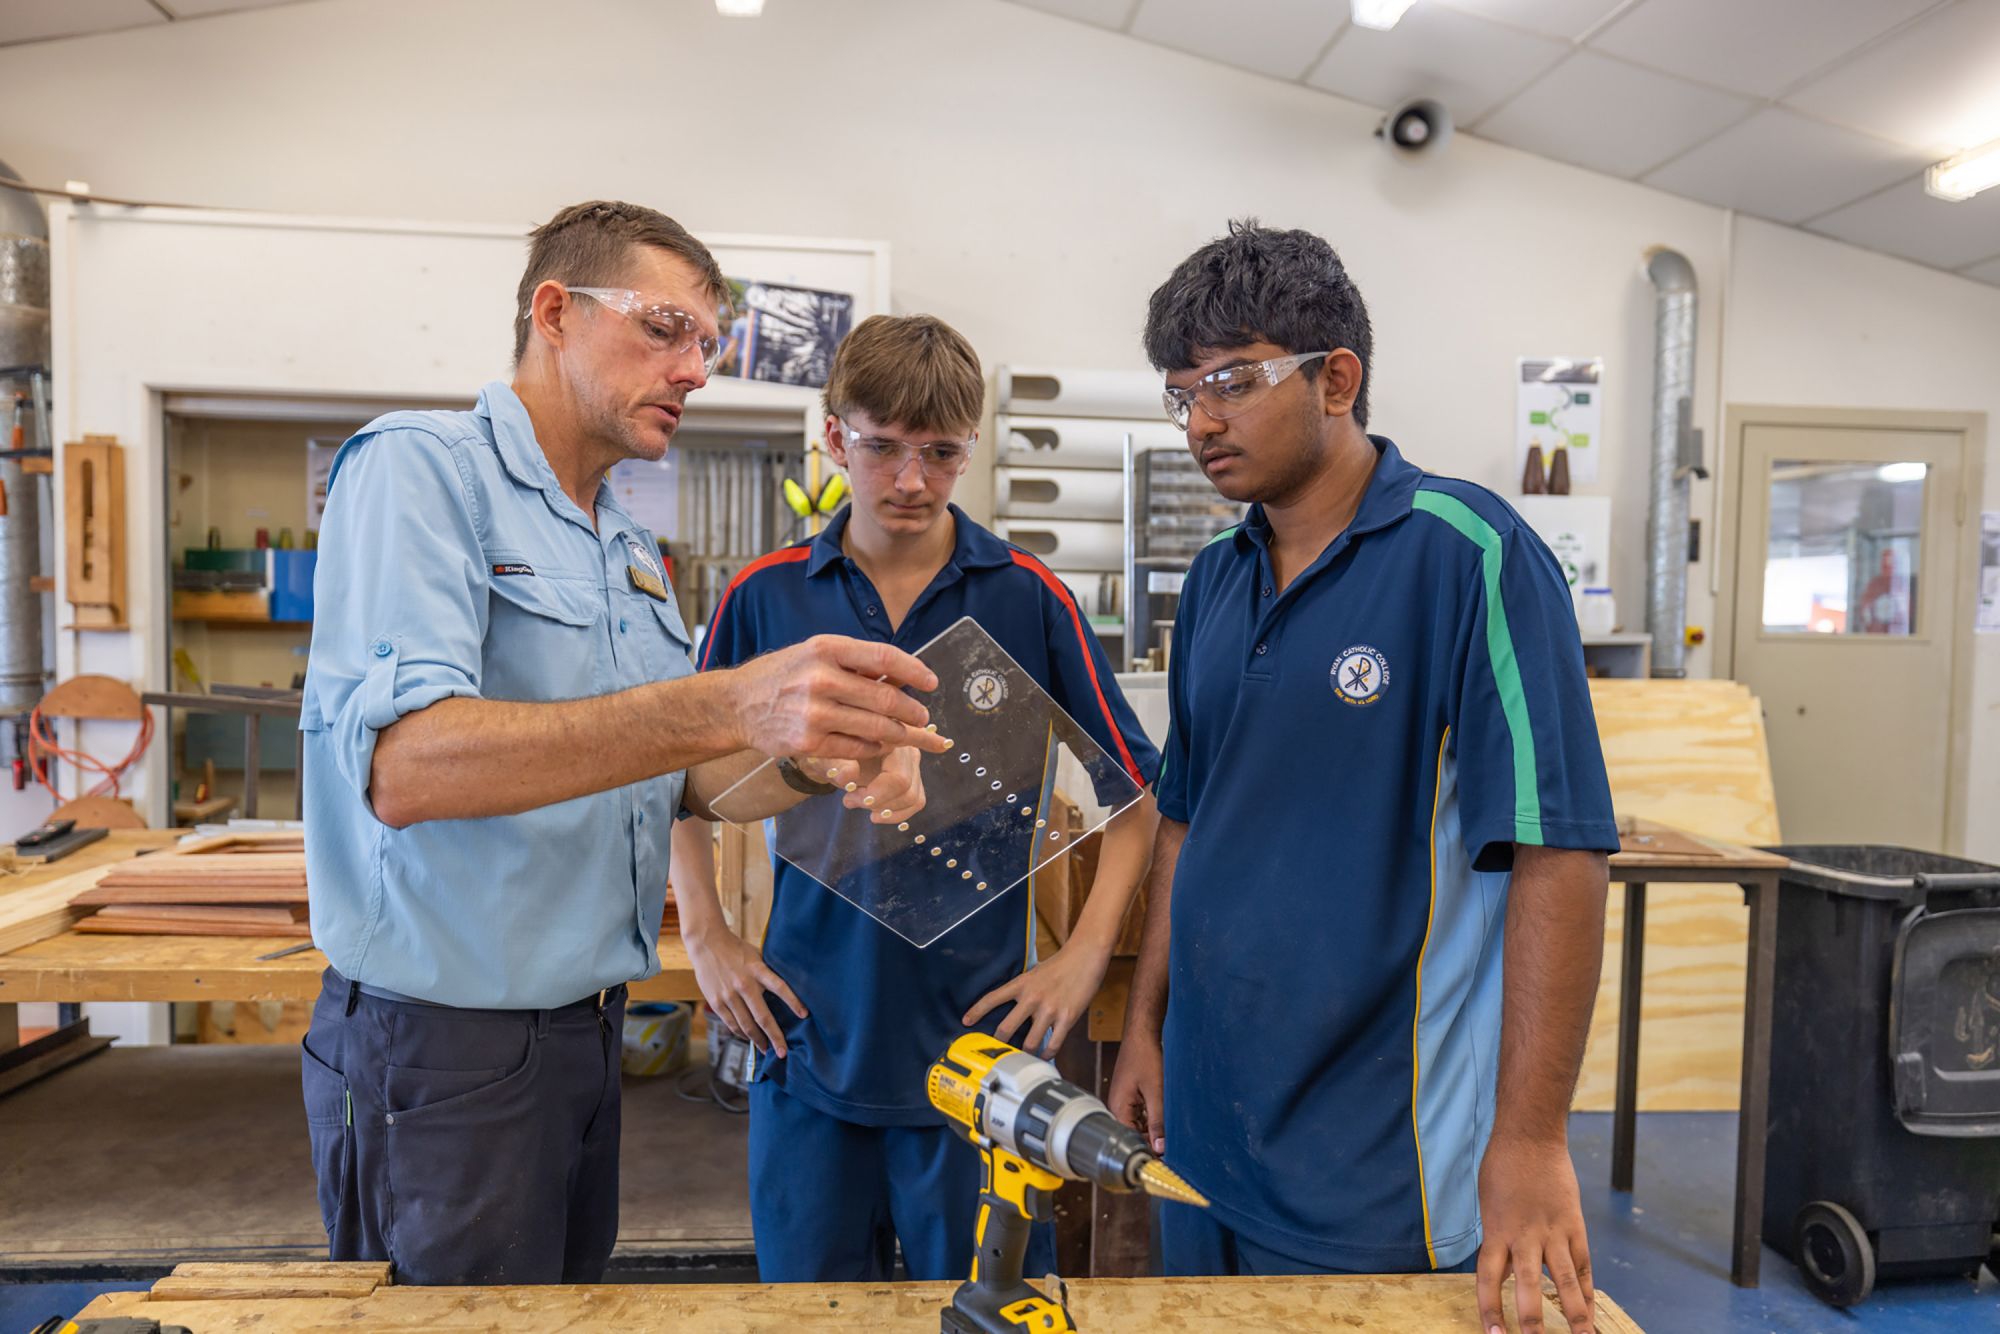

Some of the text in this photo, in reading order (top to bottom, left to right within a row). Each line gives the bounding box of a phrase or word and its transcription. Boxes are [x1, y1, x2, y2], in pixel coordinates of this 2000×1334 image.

[1330, 646, 1390, 685] RYAN CATHOLIC COLLEGE
